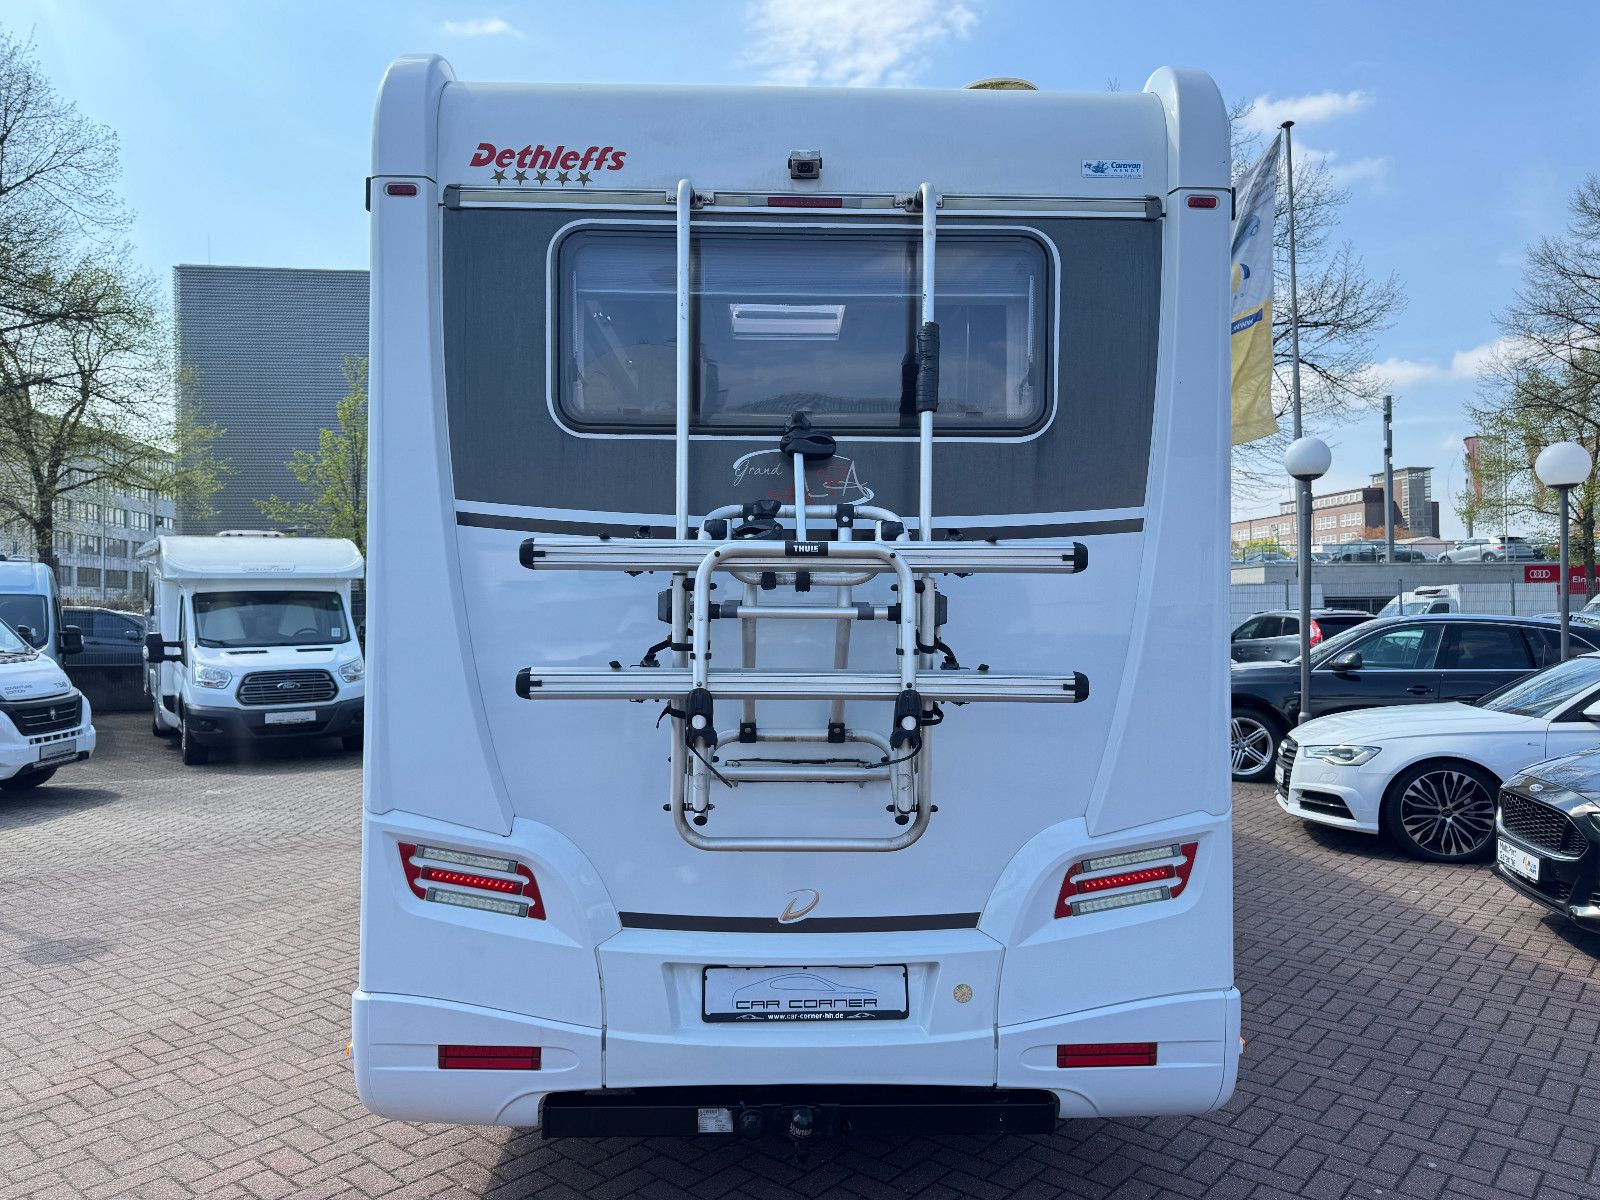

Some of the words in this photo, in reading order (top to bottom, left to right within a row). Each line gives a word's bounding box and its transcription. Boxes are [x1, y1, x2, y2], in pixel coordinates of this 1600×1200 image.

[470, 142, 627, 171] Dethleffs
[1111, 161, 1141, 169] Caravan
[734, 460, 783, 487] Grand
[793, 544, 819, 553] THULE
[735, 999, 781, 1010] CAR
[788, 998, 878, 1009] CORNER
[767, 1012, 844, 1020] www.car-corner-hh.de
